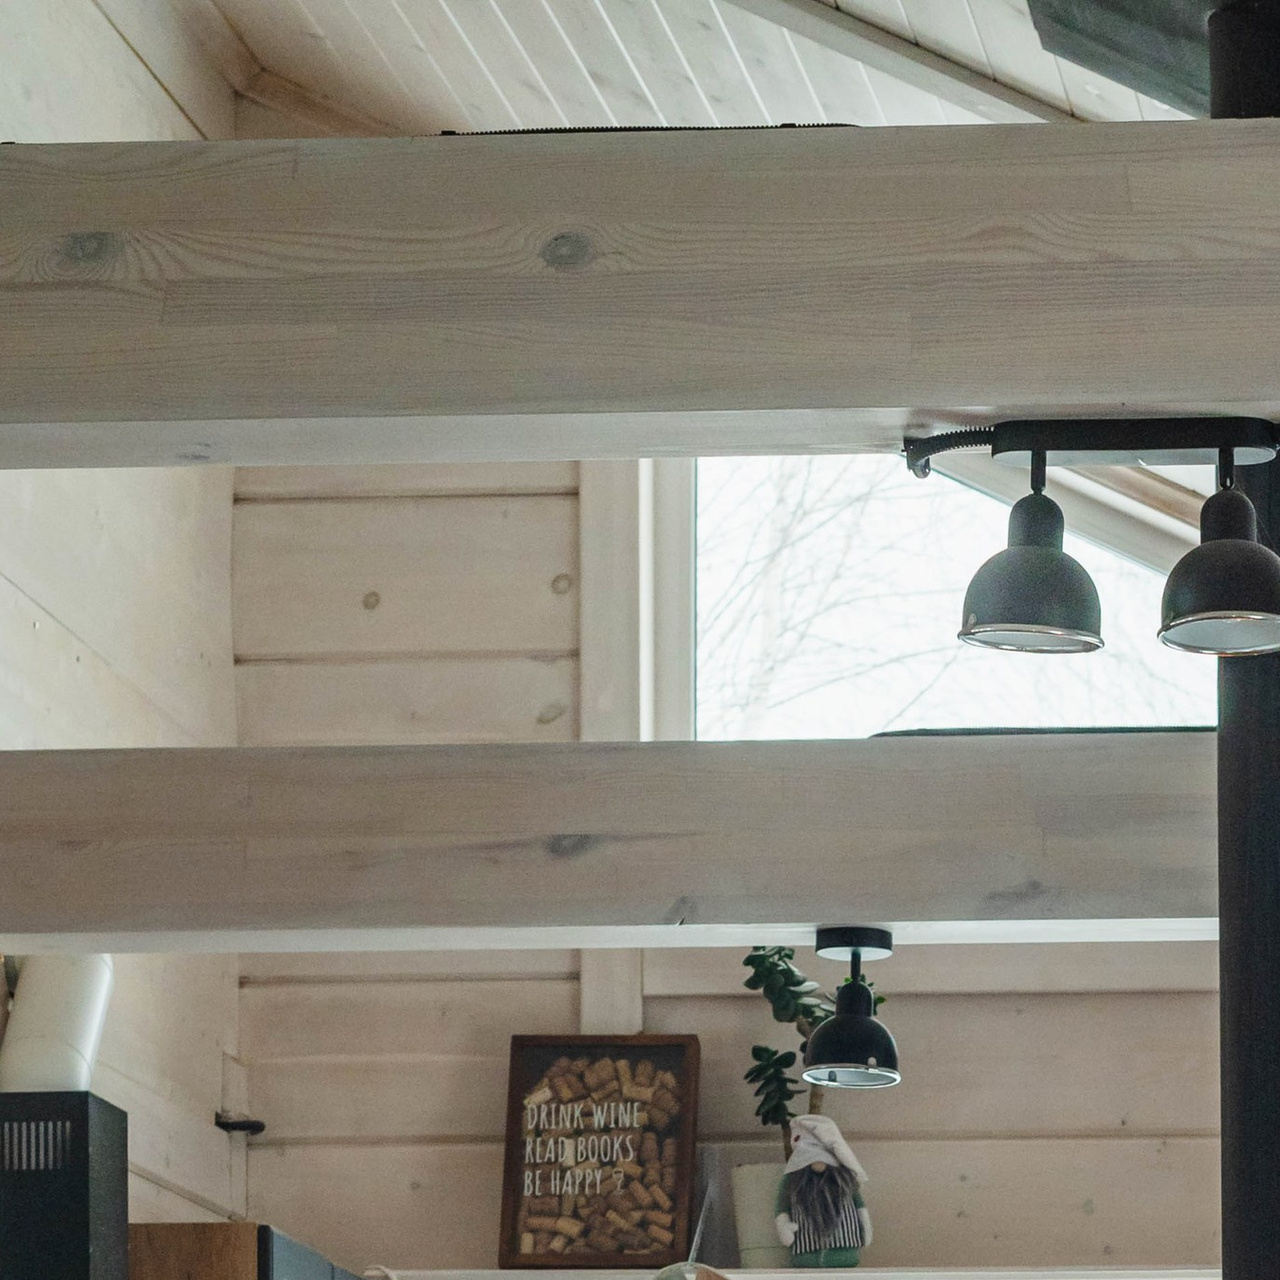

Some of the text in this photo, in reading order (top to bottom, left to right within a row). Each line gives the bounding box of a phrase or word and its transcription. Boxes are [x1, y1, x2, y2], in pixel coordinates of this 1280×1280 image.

[527, 1101, 641, 1129] DRINK WINE
[525, 1134, 634, 1163] READ BOOKS
[523, 1168, 602, 1197] BE HAPPY
